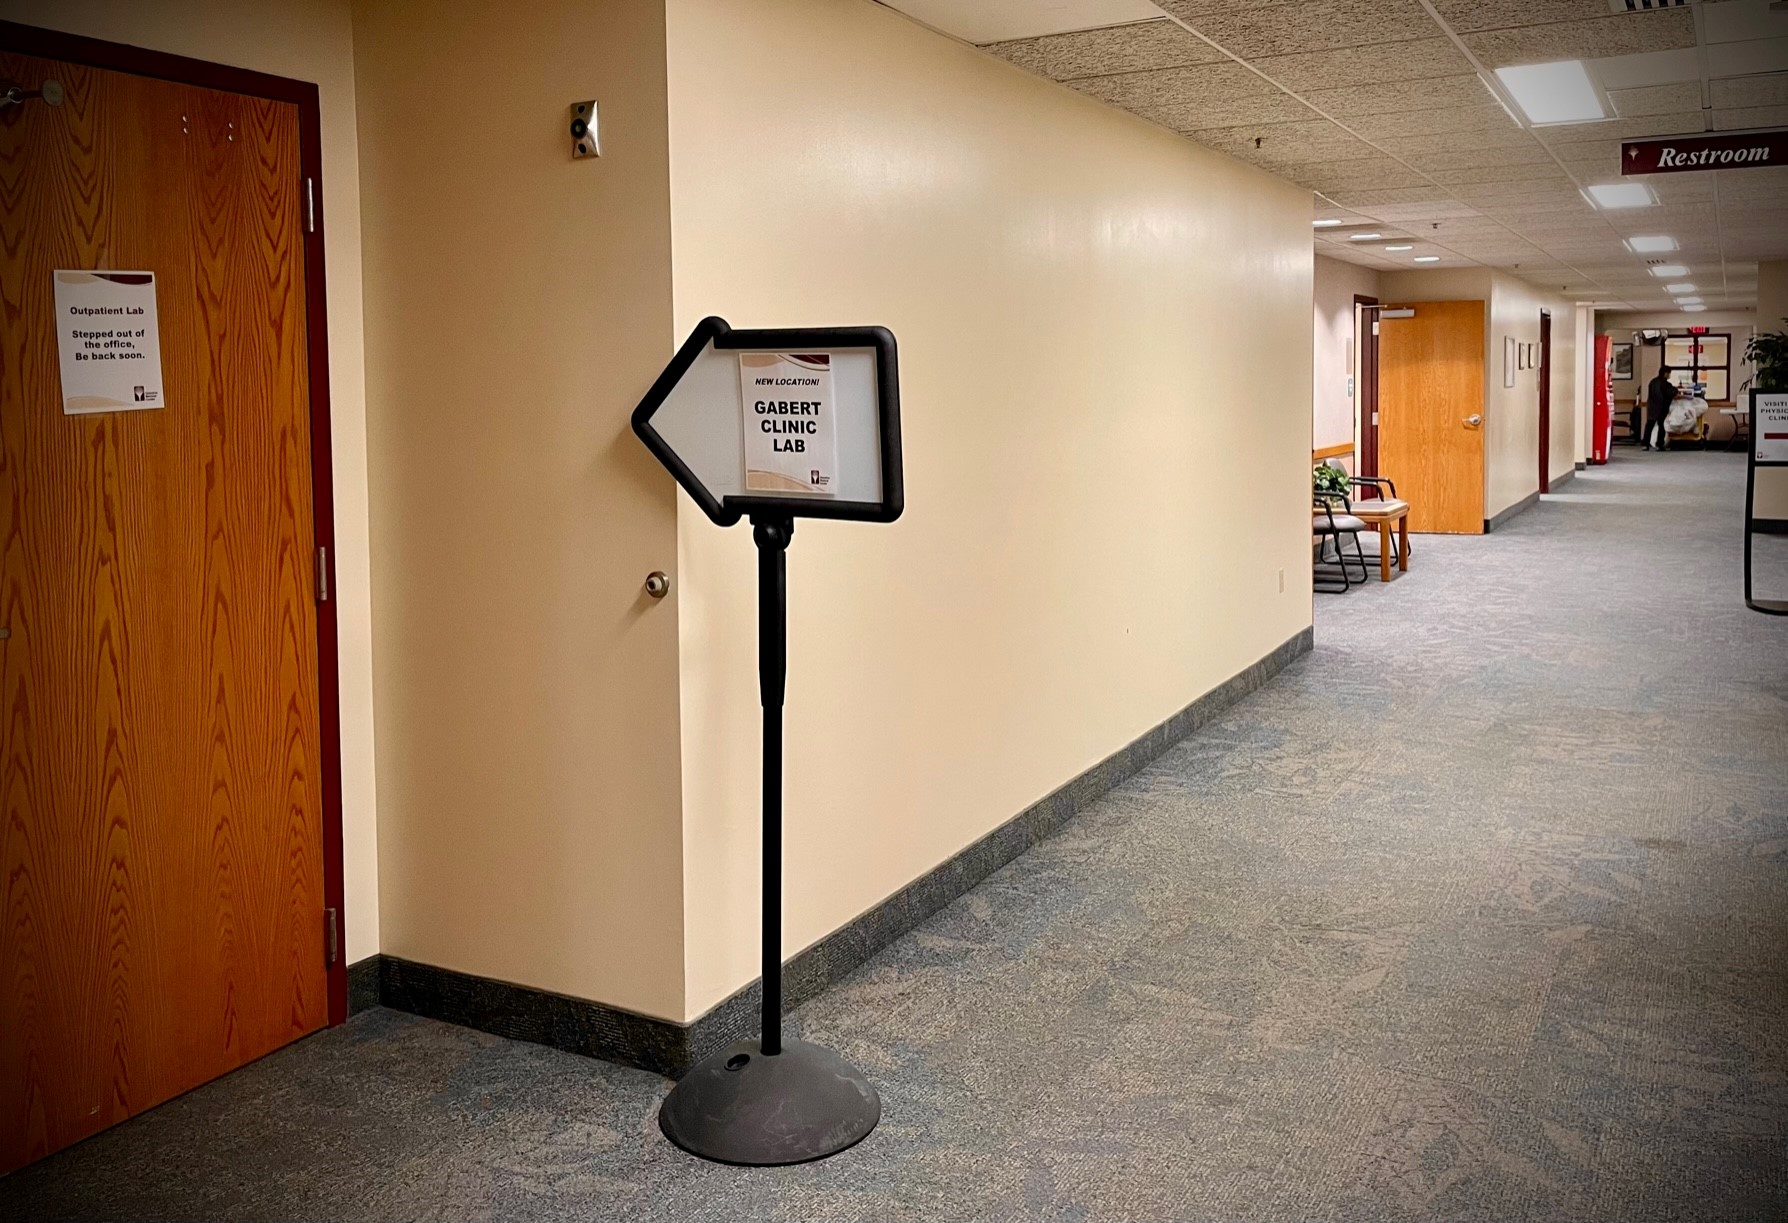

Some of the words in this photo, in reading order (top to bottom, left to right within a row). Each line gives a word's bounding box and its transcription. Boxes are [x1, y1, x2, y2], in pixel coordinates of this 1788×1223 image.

[1657, 147, 1770, 168] Restroom
[70, 306, 123, 316] Outpatient
[126, 306, 144, 315] Lab
[72, 330, 113, 340] Stepped
[116, 330, 133, 338] out
[135, 329, 145, 337] of
[84, 340, 101, 349] the
[103, 340, 135, 350] office,
[75, 352, 89, 361] Be
[91, 352, 116, 360] back
[118, 352, 146, 360] soon.
[775, 378, 820, 386] LOCATION!
[754, 401, 821, 415] GABERT
[761, 420, 817, 434] CLINIC
[773, 438, 805, 453] LAB
